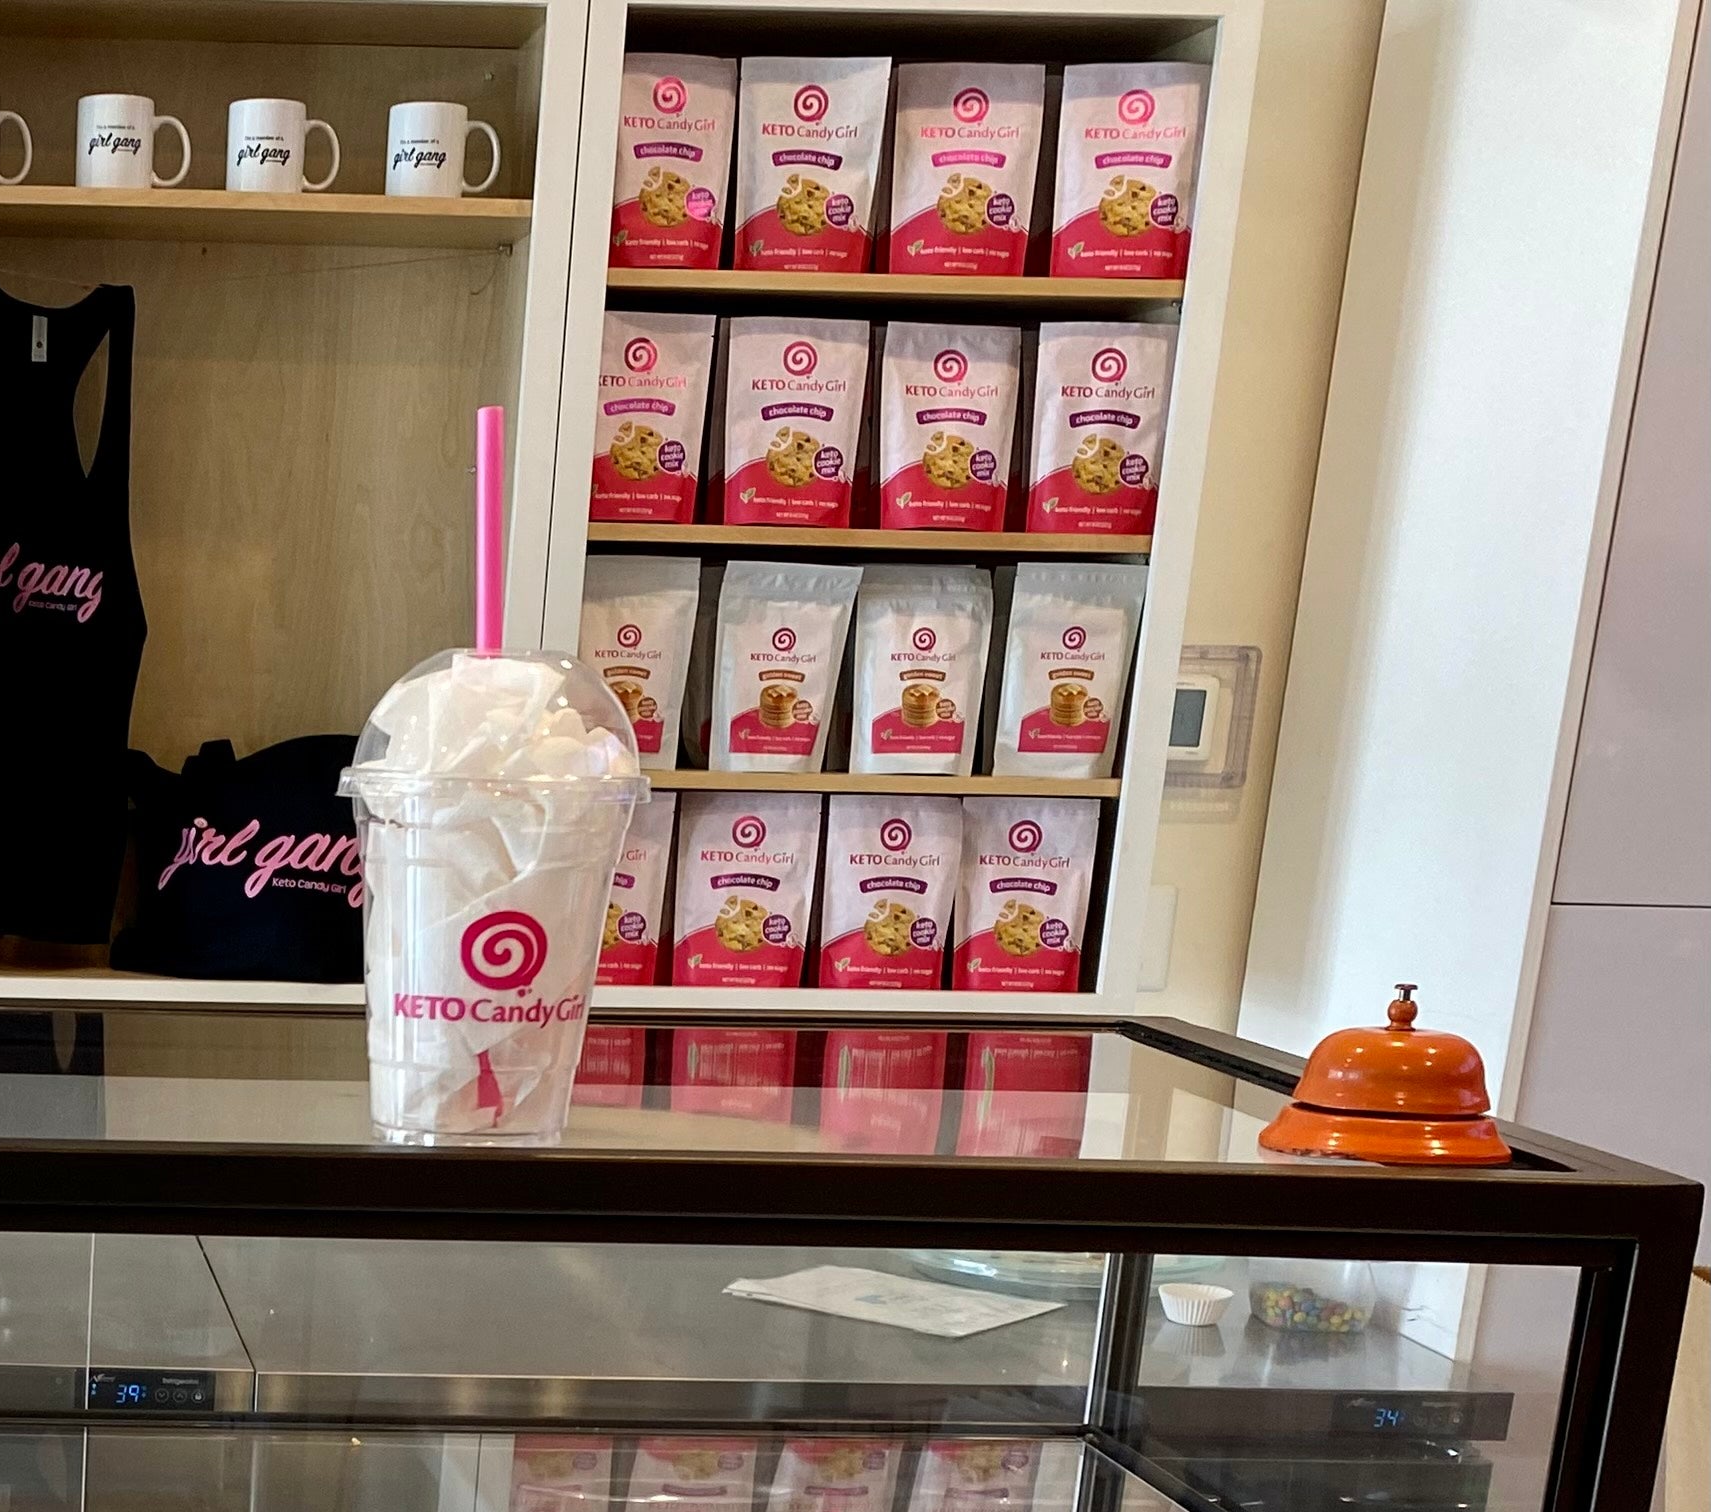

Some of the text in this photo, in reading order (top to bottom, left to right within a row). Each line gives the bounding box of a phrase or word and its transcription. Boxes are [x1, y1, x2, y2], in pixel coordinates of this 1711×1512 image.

[624, 116, 716, 132] KETO Candy Girl
[762, 124, 858, 140] KETO Candy Girl
[920, 126, 1019, 140] KETO Candy Girl
[1085, 126, 1186, 141] KETO Candy Girl
[88, 132, 142, 155] girl gang
[237, 144, 290, 166] girl gang
[640, 144, 696, 159] chocolate chip
[392, 148, 446, 170] girl gang
[779, 152, 835, 167] chocolate chip
[628, 376, 665, 389] Candy
[752, 379, 846, 393] KETO Candy Girl
[905, 384, 998, 398] KETO Candy Girl
[1061, 385, 1155, 400] KETO Candy Girl
[610, 400, 669, 413] chocolate chip
[769, 406, 827, 419] chocolate chip
[923, 411, 980, 423] chocolate chip
[1076, 412, 1133, 425] chocolate chip
[13, 562, 103, 623] gang
[594, 649, 662, 660] KETO Candy Girl
[750, 653, 816, 664] KETO Candy Girl
[891, 652, 956, 663] KETO Candy Girl
[1040, 651, 1105, 662] KETO Candy Girl
[626, 849, 647, 861] Girl
[701, 851, 794, 864] KETO Candy Girl
[850, 854, 940, 868] KETO Candy Girl
[979, 855, 1070, 869] KETO Candy Girl
[272, 877, 296, 888] Keto
[298, 879, 329, 892] Candy
[717, 875, 772, 888] chocolate chip
[867, 880, 921, 891] chocolate chip
[997, 881, 1050, 893] chocolate chip
[394, 993, 586, 1029] KETO Candy Girl
[116, 1384, 139, 1403] 39
[1374, 1408, 1399, 1428] 34
